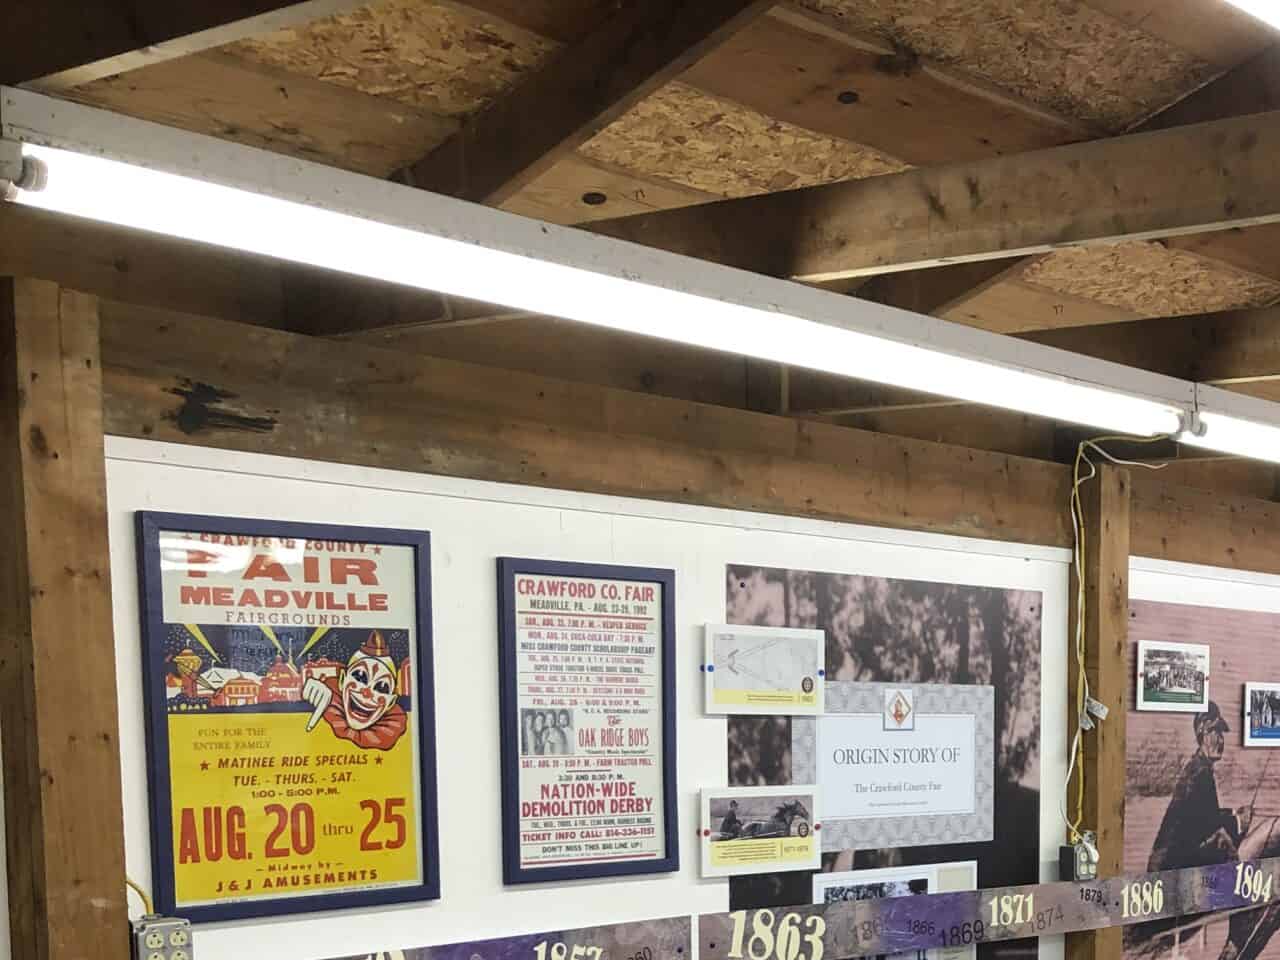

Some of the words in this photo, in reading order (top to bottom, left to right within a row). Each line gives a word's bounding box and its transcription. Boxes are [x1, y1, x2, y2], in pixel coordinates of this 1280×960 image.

[180, 585, 389, 611] MEADVILLE
[517, 579, 596, 599] CRAWFORD
[601, 584, 622, 600] CO.
[625, 586, 654, 602] FAIR
[225, 611, 351, 626] FAIRGROUNDS
[578, 728, 596, 747] OAK
[600, 728, 624, 747] RIDGE
[628, 728, 649, 747] BOYS
[217, 756, 275, 769] MATINEE
[281, 755, 311, 767] RIDE
[315, 754, 368, 767] SPECIALS
[833, 748, 889, 765] ORIGIN
[893, 747, 938, 764] STORY
[941, 747, 960, 762] OF
[233, 774, 261, 787] TUE.
[275, 773, 318, 785] THURS.
[331, 771, 356, 783] SAT.
[540, 782, 636, 800] NATION-WIDE
[522, 800, 605, 818] DEMOLITION
[610, 797, 653, 814] DERBY
[179, 806, 252, 864] AUG.
[264, 803, 316, 858] 20
[322, 823, 353, 836] thru
[359, 798, 407, 851] 25
[523, 833, 552, 842] TICKET
[216, 882, 223, 892] J
[228, 880, 239, 891] &
[246, 879, 252, 890] J
[263, 869, 378, 888] AMUSEMENTS
[907, 920, 936, 936] 1866
[940, 919, 985, 946] 1869
[988, 892, 1034, 927] 1871
[1030, 904, 1065, 934] 1874
[1079, 887, 1103, 904] 1879
[1120, 879, 1164, 918] 1886
[1233, 862, 1274, 902] 1894
